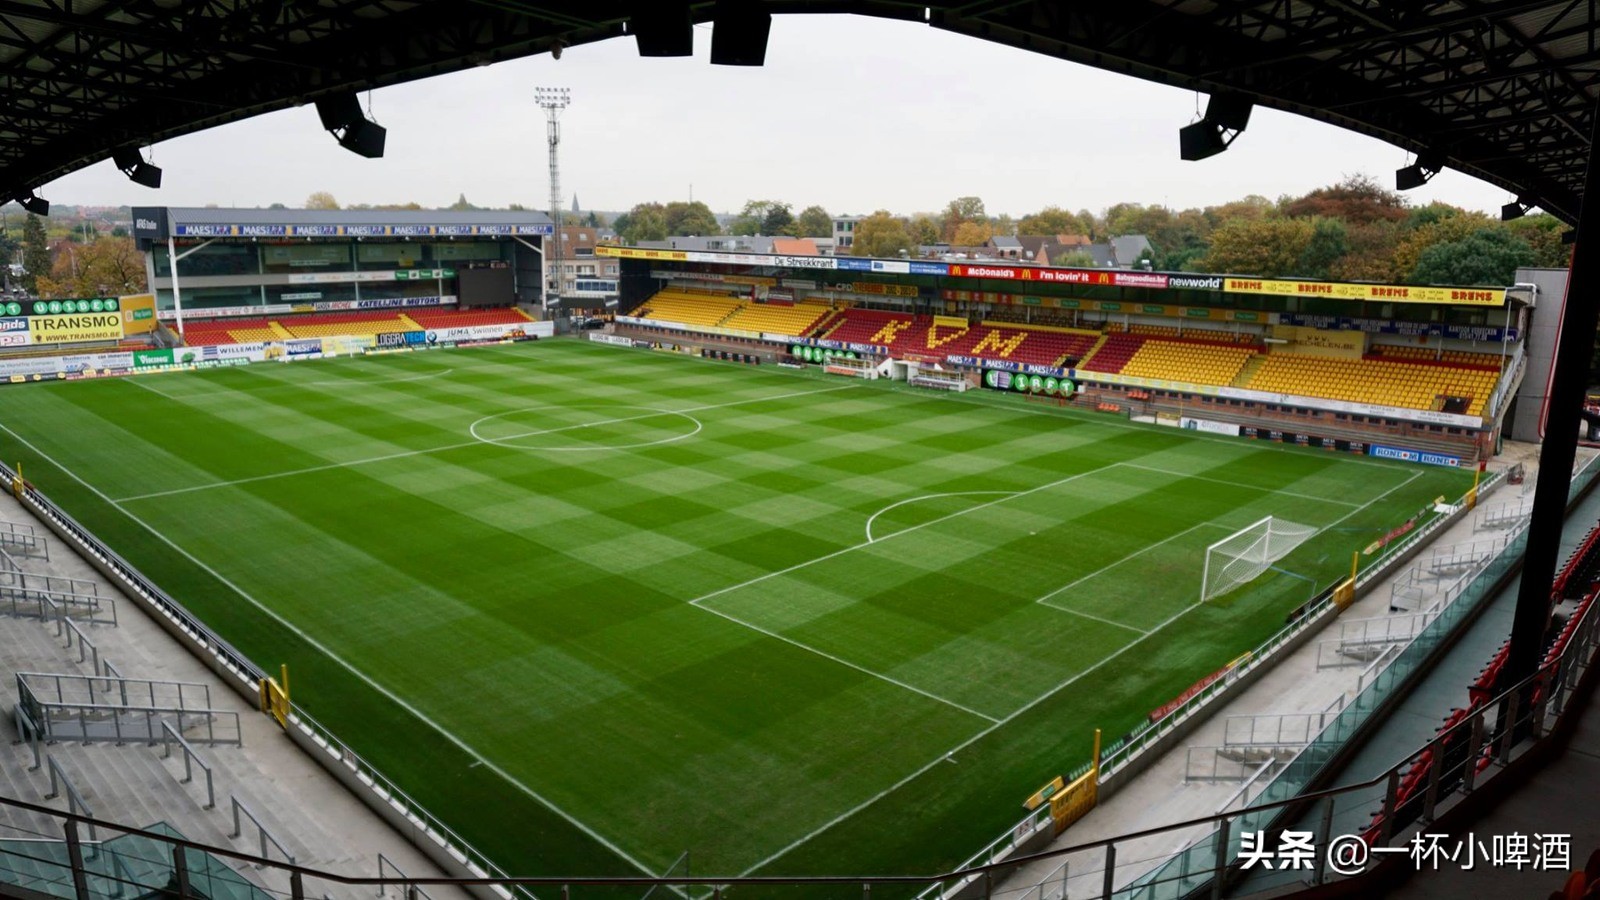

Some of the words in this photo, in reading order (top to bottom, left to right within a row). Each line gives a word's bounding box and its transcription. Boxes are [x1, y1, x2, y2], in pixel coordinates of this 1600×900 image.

[185, 226, 211, 235] MAES
[243, 226, 268, 235] MAES
[296, 226, 320, 235] MAES
[347, 226, 369, 235] MAES
[394, 226, 415, 234] MAES
[438, 226, 458, 234] MAES
[480, 226, 498, 234] MAES
[519, 226, 537, 234] MAES
[774, 256, 784, 265] De
[787, 257, 834, 268] Streekkrant
[967, 267, 1015, 278] McDonald's
[1040, 270, 1054, 280] I'm
[1056, 271, 1081, 282] lovin'
[1082, 272, 1090, 282] it
[1116, 274, 1167, 284] Babygoodies.be
[1169, 277, 1220, 288] newworld
[1231, 280, 1262, 290] BREMS
[1298, 283, 1333, 294] BREMS
[1371, 287, 1409, 298] BREMS
[1451, 291, 1493, 303] BREMS
[36, 301, 115, 312] UNIBET
[357, 298, 405, 308] KATELIJNE
[406, 297, 440, 305] MOTORS
[32, 316, 119, 331] TRANSMO
[46, 332, 121, 342] WWW.TRANSMO.BE
[447, 328, 469, 338] JUMA
[472, 326, 503, 335] Swinnen
[220, 345, 264, 354] WILLEMEN
